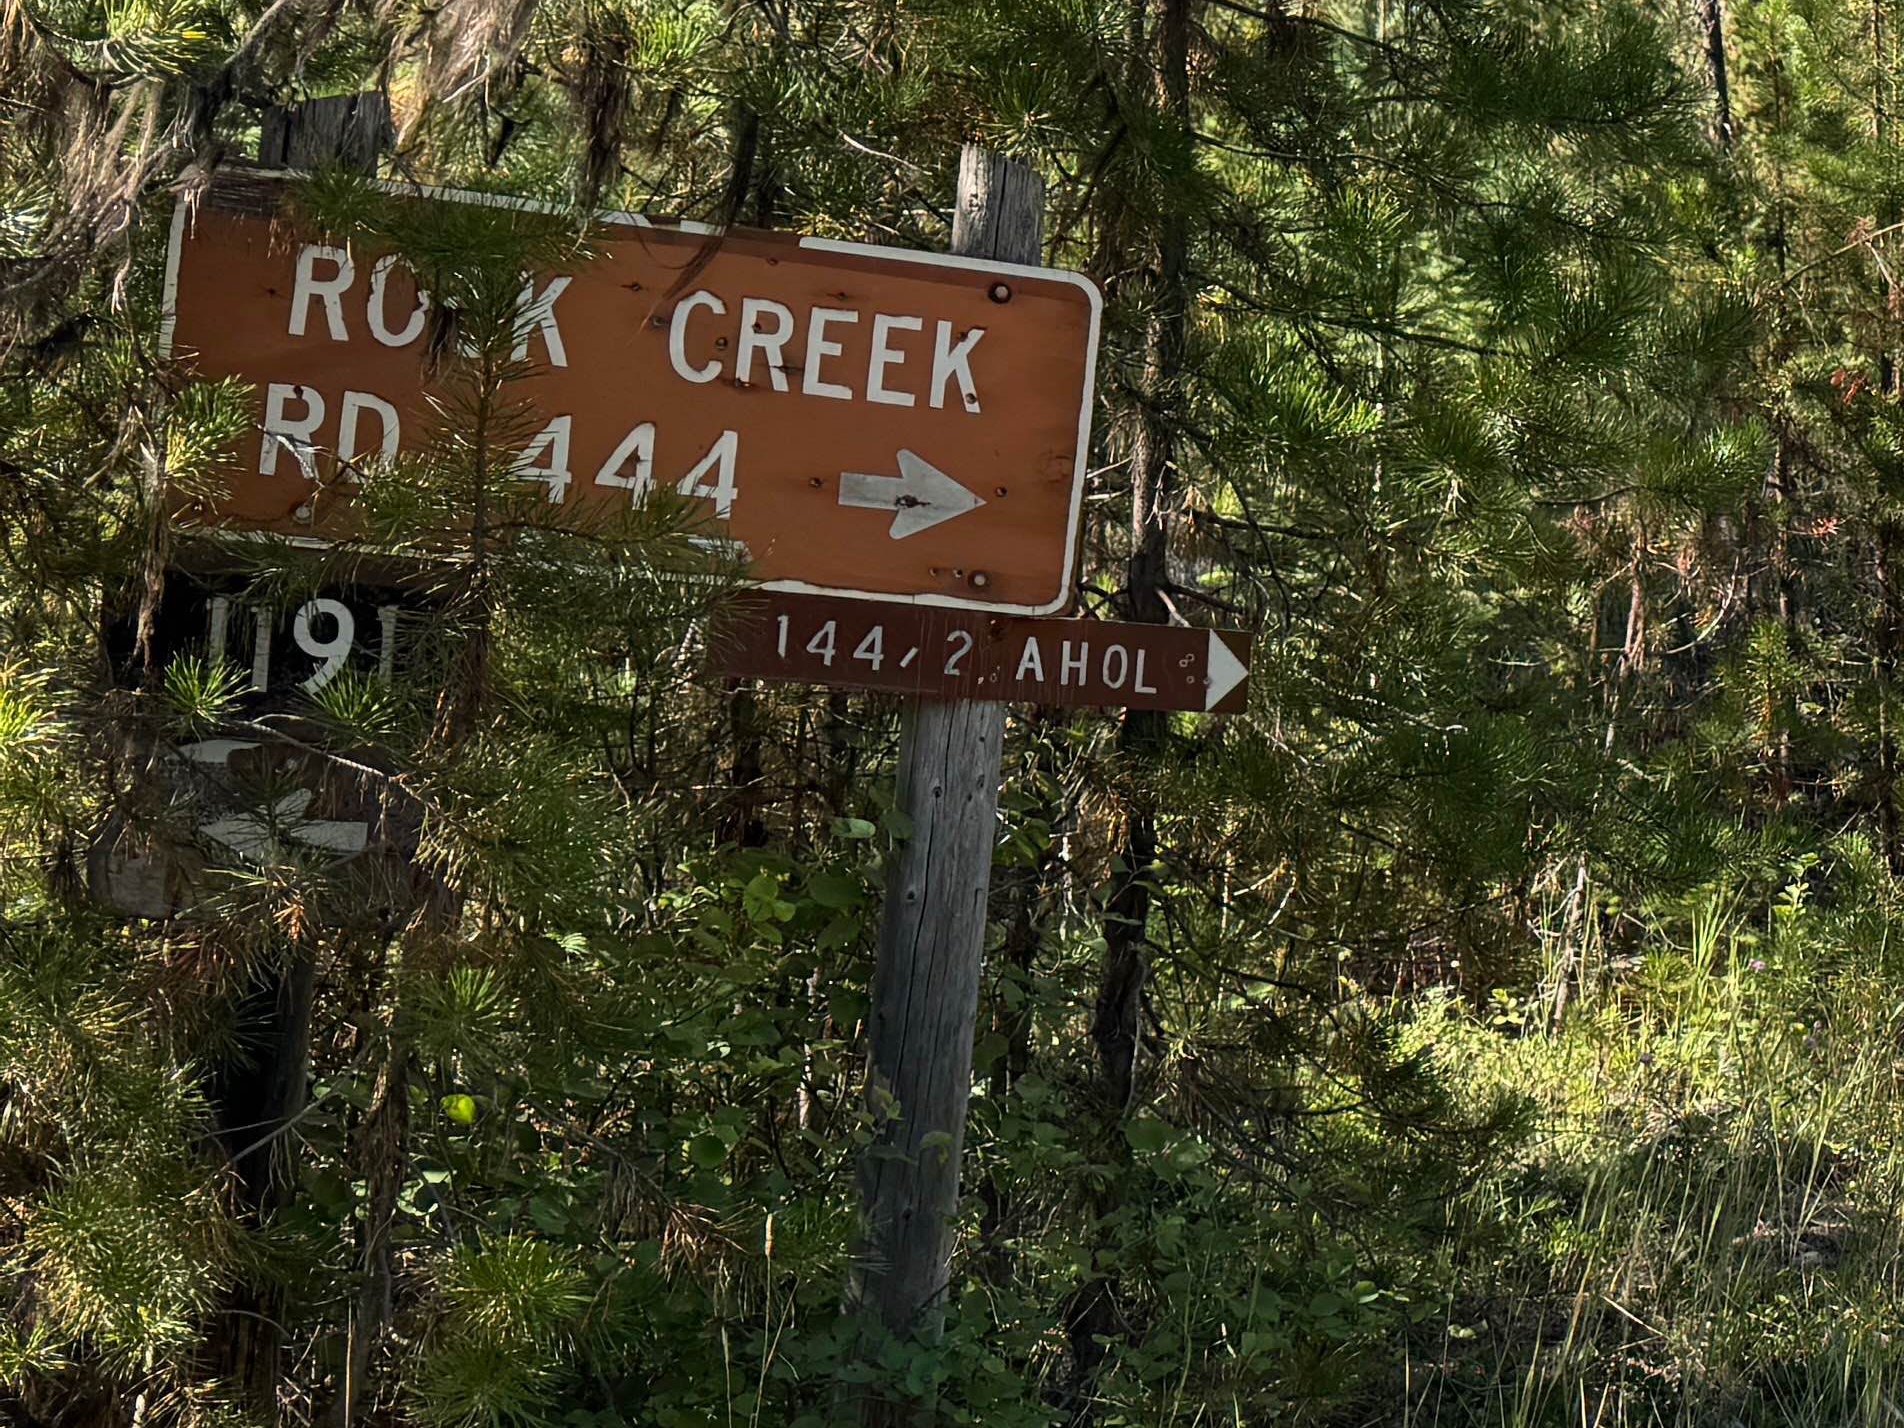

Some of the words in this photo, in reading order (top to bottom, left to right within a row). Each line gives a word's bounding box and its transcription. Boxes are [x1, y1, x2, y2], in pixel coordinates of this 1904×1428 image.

[288, 244, 573, 368] ROK
[669, 289, 986, 414] CREEK
[259, 382, 400, 485] RD
[506, 414, 739, 520] 444
[1015, 635, 1158, 695] AHOL
